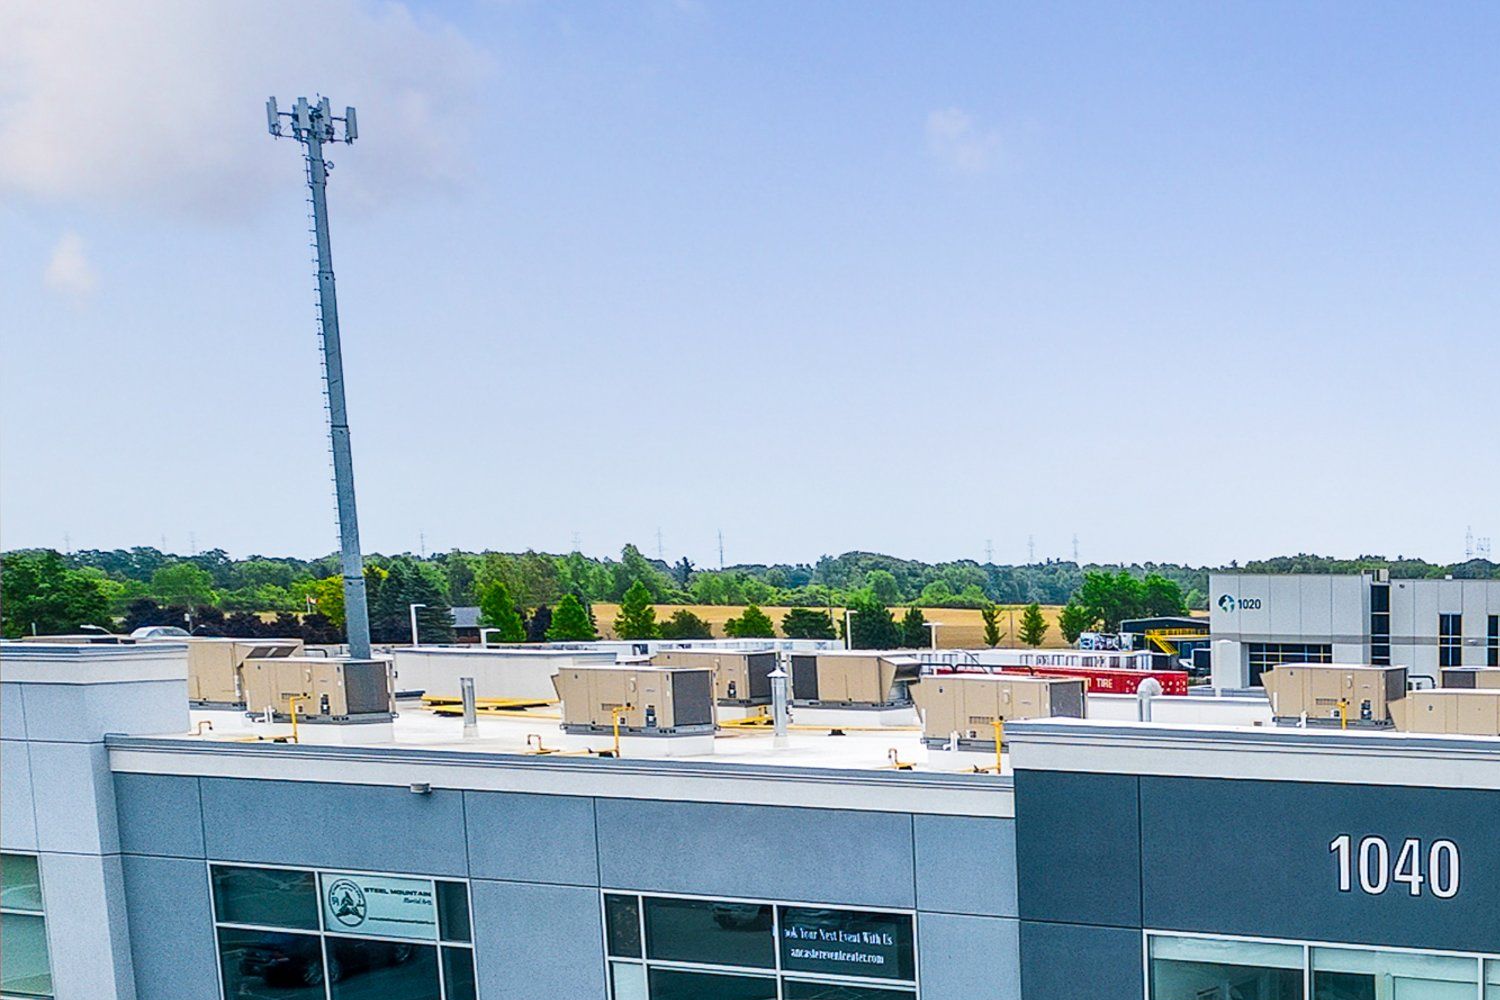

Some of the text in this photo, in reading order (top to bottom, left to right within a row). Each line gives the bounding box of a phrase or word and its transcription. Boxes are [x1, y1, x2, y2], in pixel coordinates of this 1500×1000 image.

[1237, 598, 1261, 610] 1020
[1096, 677, 1113, 689] TIRE
[1329, 834, 1460, 899] 1040
[390, 889, 432, 897] MOUNTAIN
[800, 927, 818, 941] Your
[820, 928, 837, 942] Next
[839, 929, 861, 944] Event
[862, 931, 882, 945] With
[883, 933, 893, 946] Us
